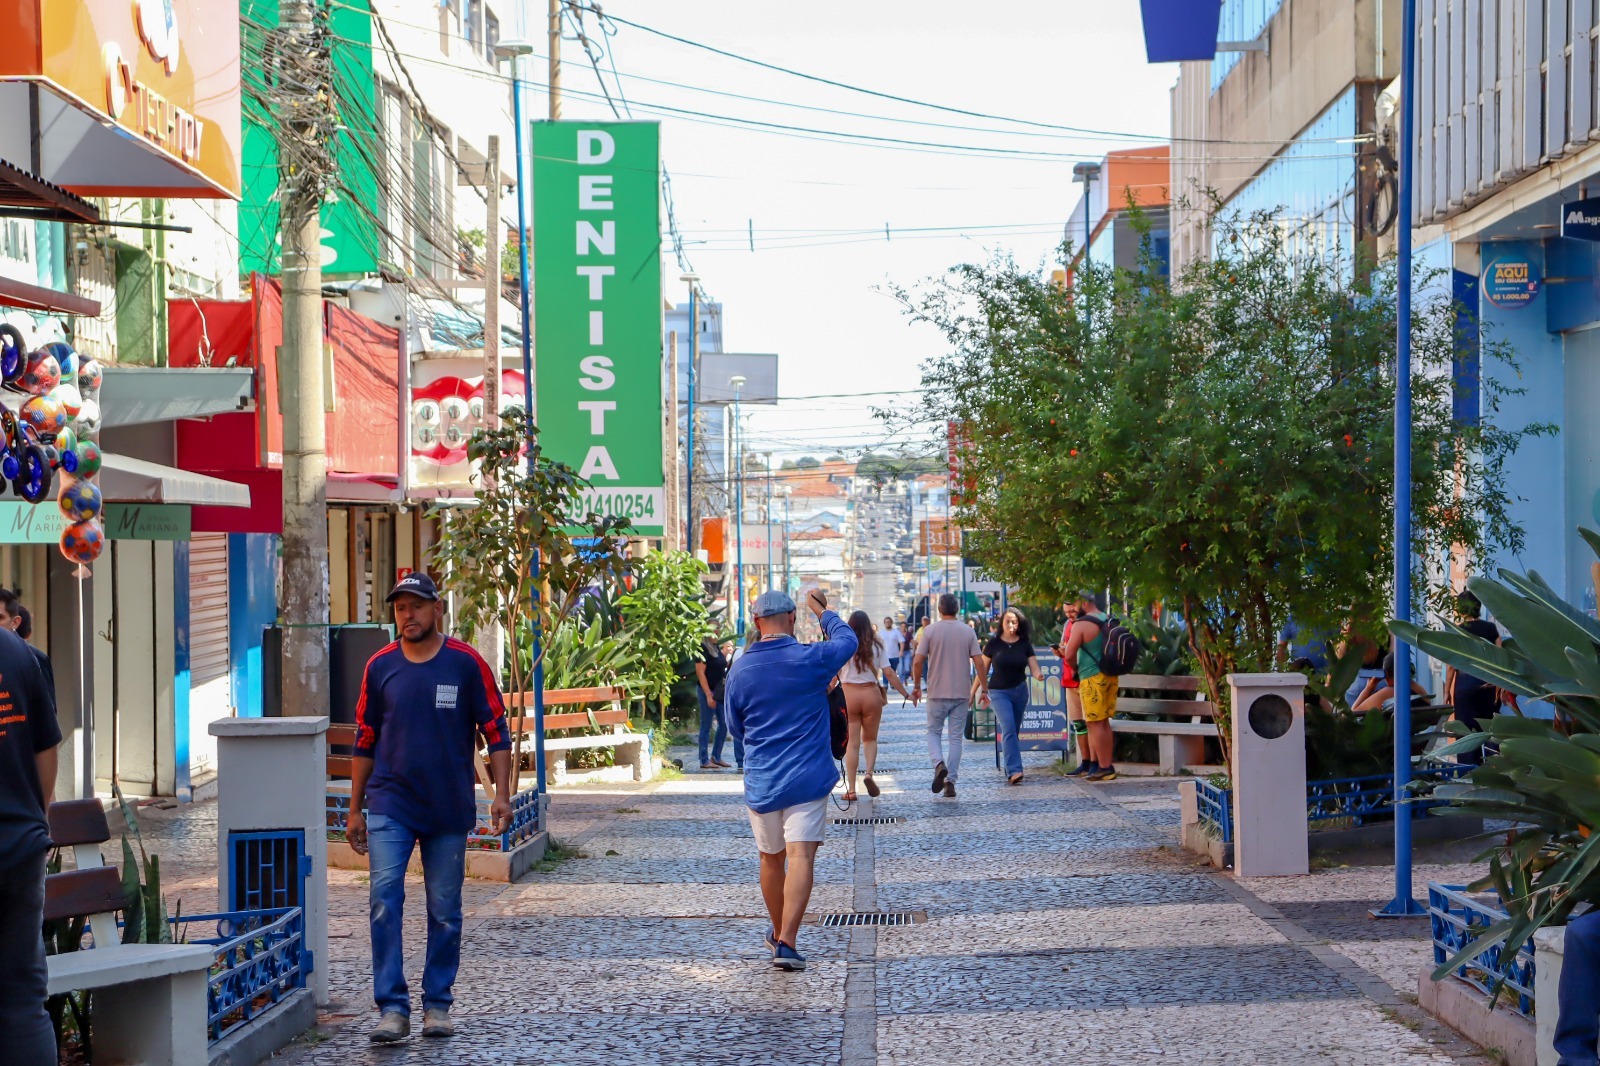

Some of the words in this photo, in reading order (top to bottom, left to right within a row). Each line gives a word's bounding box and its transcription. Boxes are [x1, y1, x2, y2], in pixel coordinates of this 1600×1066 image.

[1495, 267, 1529, 279] AQUI
[575, 129, 620, 480] DENTISTA
[10, 504, 71, 541] MARIA
[118, 506, 179, 538] MARIANA
